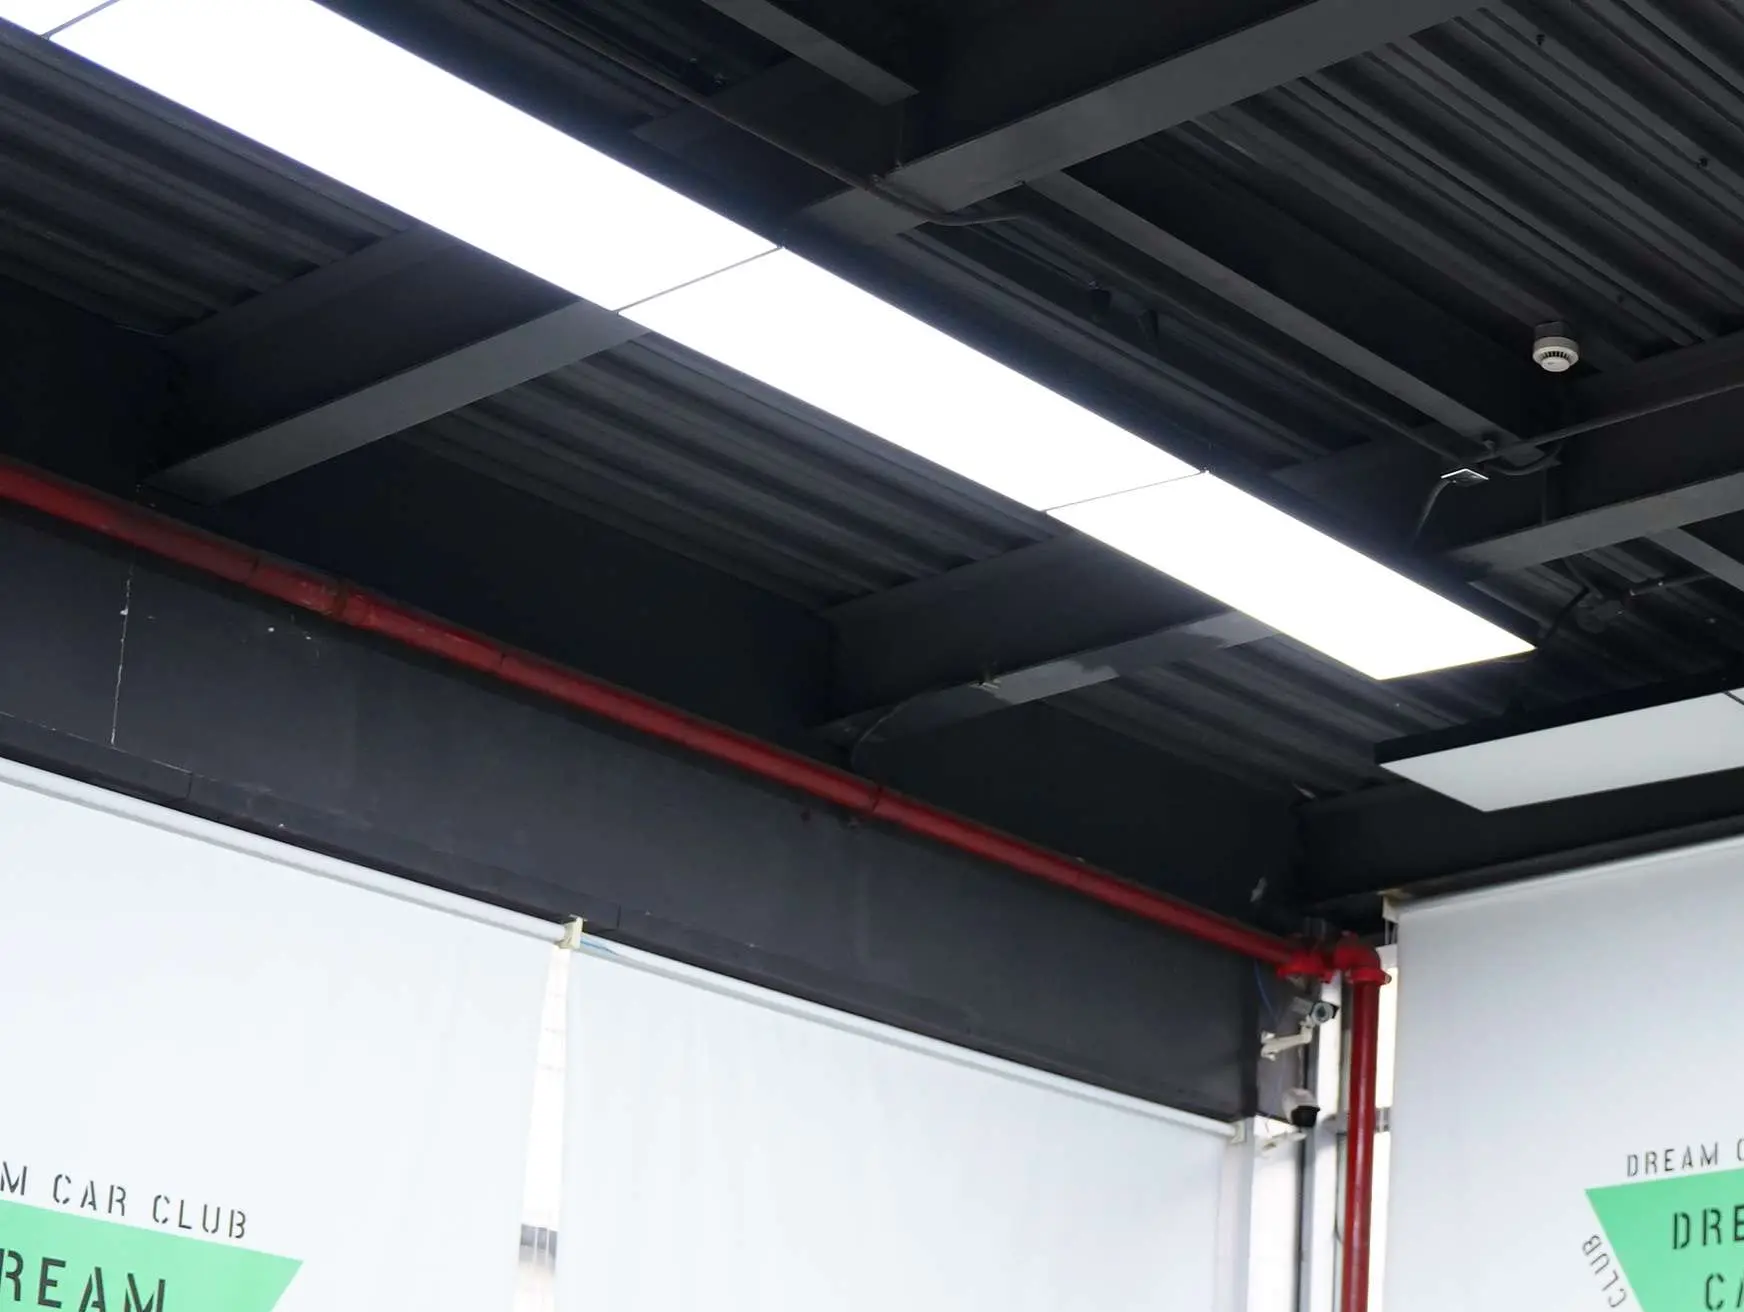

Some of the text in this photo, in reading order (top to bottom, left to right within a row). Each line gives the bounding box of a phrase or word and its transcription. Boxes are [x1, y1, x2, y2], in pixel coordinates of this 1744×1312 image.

[1627, 1142, 1718, 1177] DREAM
[52, 1173, 127, 1217] CAR
[152, 1194, 246, 1240] CLUB
[1581, 1233, 1627, 1309] CLUB
